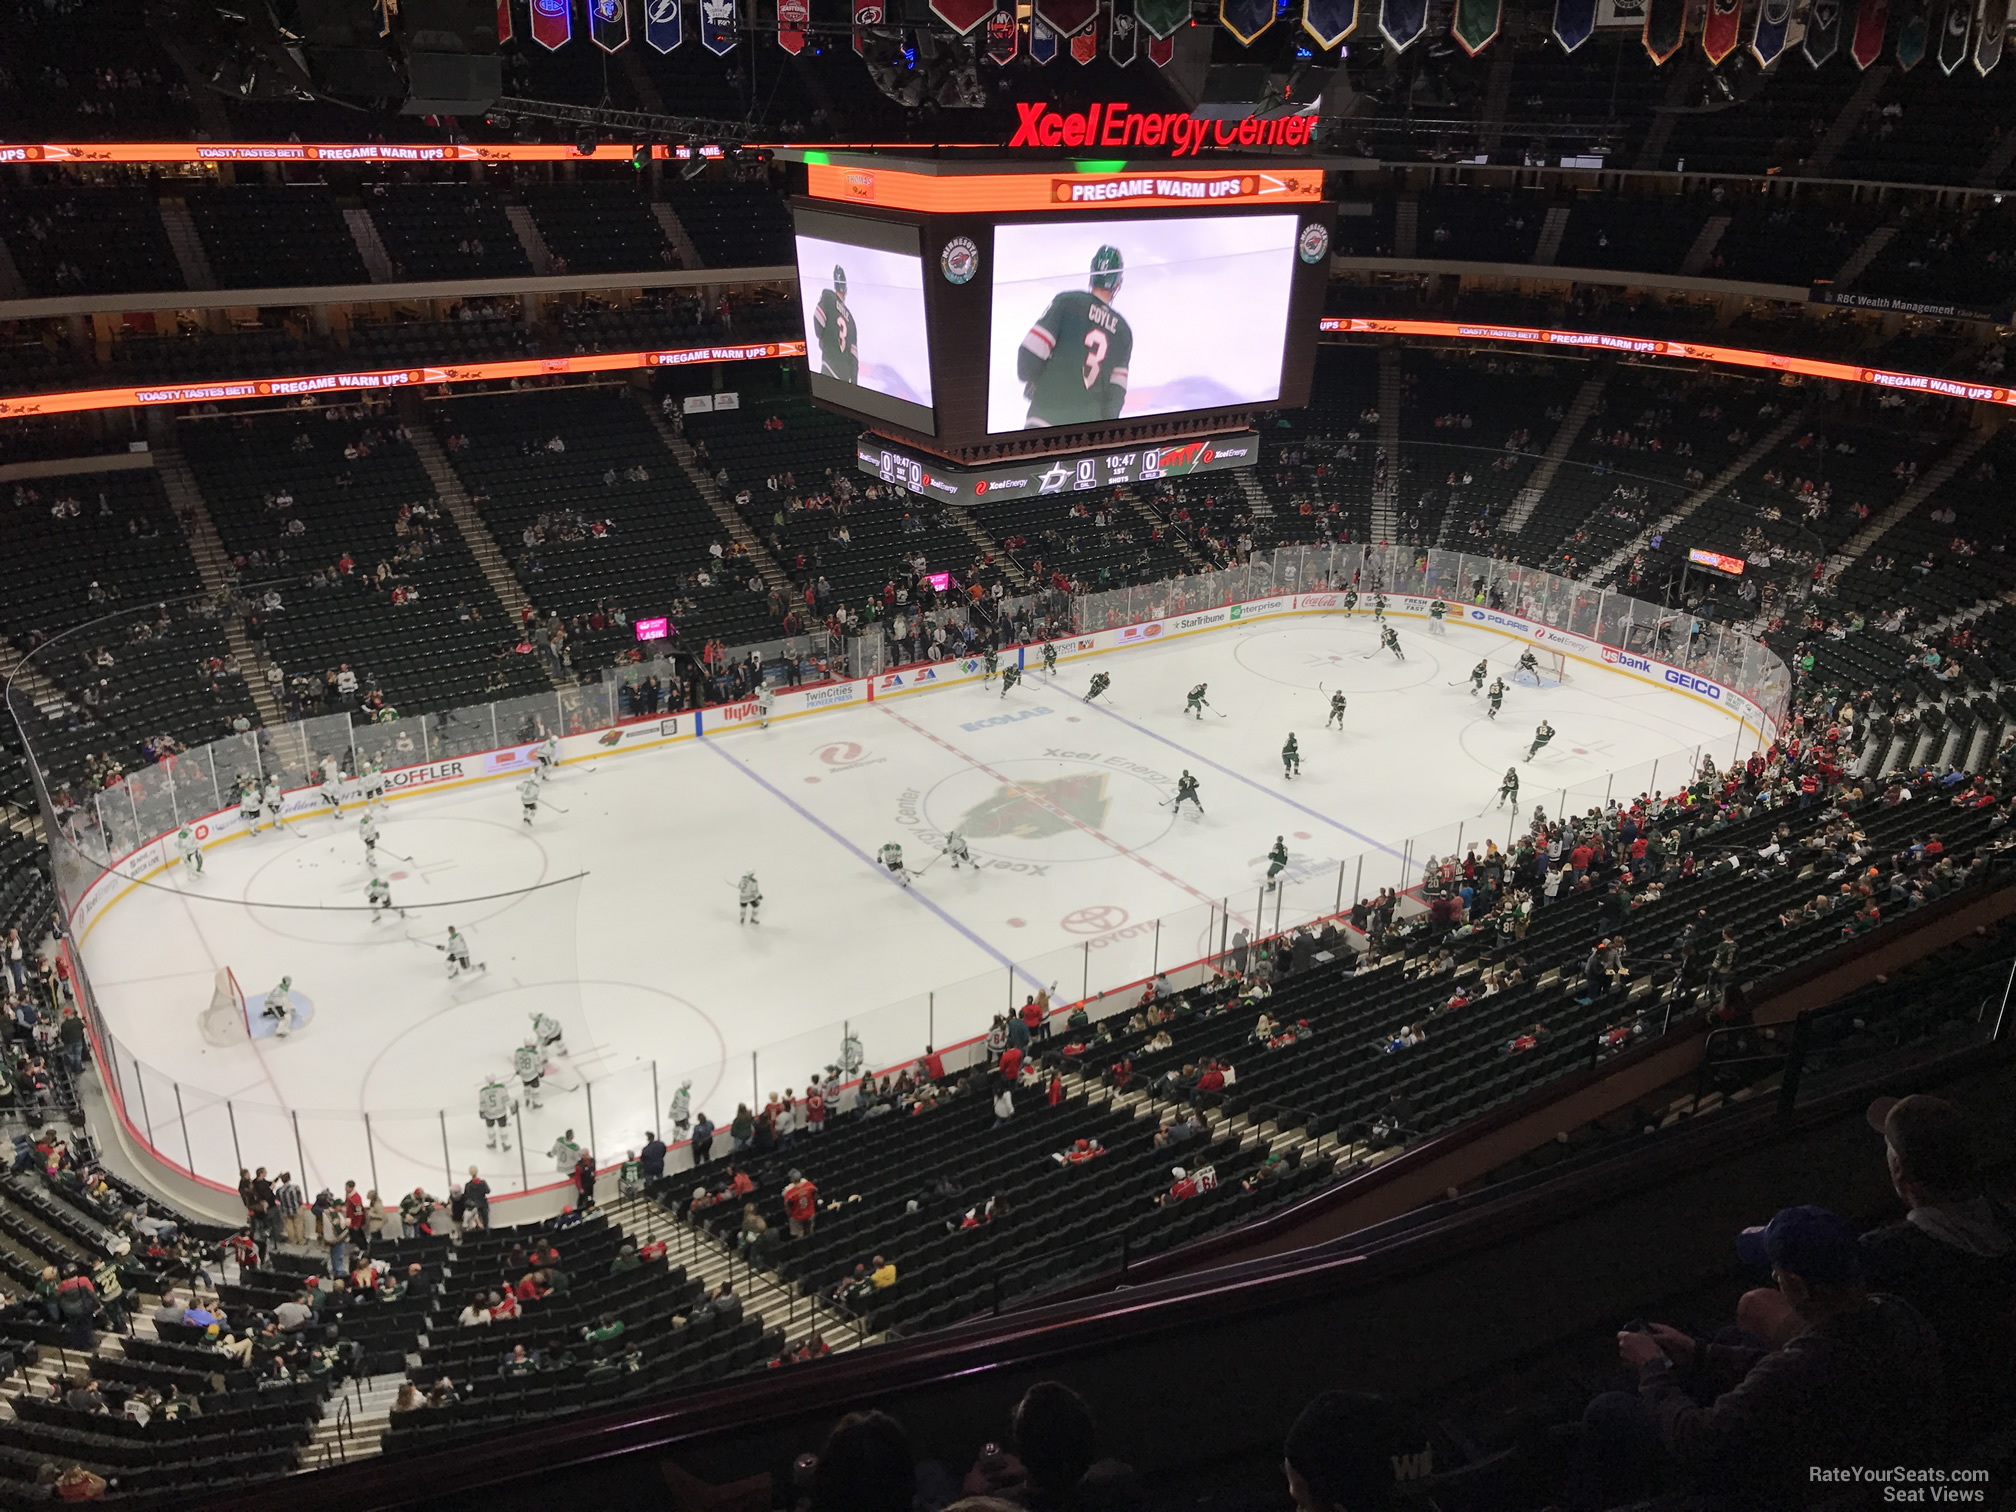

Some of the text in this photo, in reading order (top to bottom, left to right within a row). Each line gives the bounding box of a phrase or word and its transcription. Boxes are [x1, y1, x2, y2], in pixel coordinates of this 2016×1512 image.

[1008, 102, 1101, 147] Xcel
[1100, 103, 1209, 157] Energy
[198, 149, 237, 158] TOASTY
[238, 149, 276, 158] TASTES
[318, 147, 443, 159] PREGAME WARM UPS
[1072, 179, 1241, 200] PREGAME WARM UPS
[942, 238, 977, 259] MINNESOTA
[1836, 293, 1856, 305] RBC
[1857, 296, 1890, 309] Wealth
[1891, 299, 1955, 316] Management
[1088, 303, 1119, 334] COYLE
[1320, 321, 1339, 331] UPS
[836, 315, 848, 353] 3
[1459, 327, 1488, 337] TOASTY
[1489, 329, 1516, 339] TASTES
[1550, 333, 1655, 352] PREGAME WARM UPS
[659, 347, 766, 364] PREGAME WARM UPS
[1082, 328, 1109, 390] 3
[272, 374, 408, 394] PREGAME WARM UPS
[1874, 374, 1993, 399] PREGAME WARM UPS
[137, 390, 181, 401] TOASTY
[183, 388, 224, 399] TASTES
[893, 453, 910, 468] 10:47
[1105, 453, 1136, 469] 10:47
[1146, 453, 1156, 470] 0
[1079, 462, 1091, 480] 0
[1108, 476, 1129, 484] SHOTS
[1231, 600, 1282, 617] enterprise
[1487, 614, 1529, 633] POLARIS
[640, 630, 666, 641] LASIK
[1664, 669, 1721, 700] GEICO
[807, 694, 853, 708] PIONEER PRESS
[959, 706, 1056, 732] ECOLAB
[1539, 727, 1548, 735] 12
[1042, 748, 1101, 761] Xcel
[1103, 756, 1179, 785] Energy
[1428, 879, 1440, 888] 20
[1074, 920, 1166, 953] TOYOTA
[519, 1057, 531, 1070] 28
[489, 1095, 497, 1108] 5
[1202, 1173, 1217, 1191] 64
[102, 1273, 119, 1294] 22
